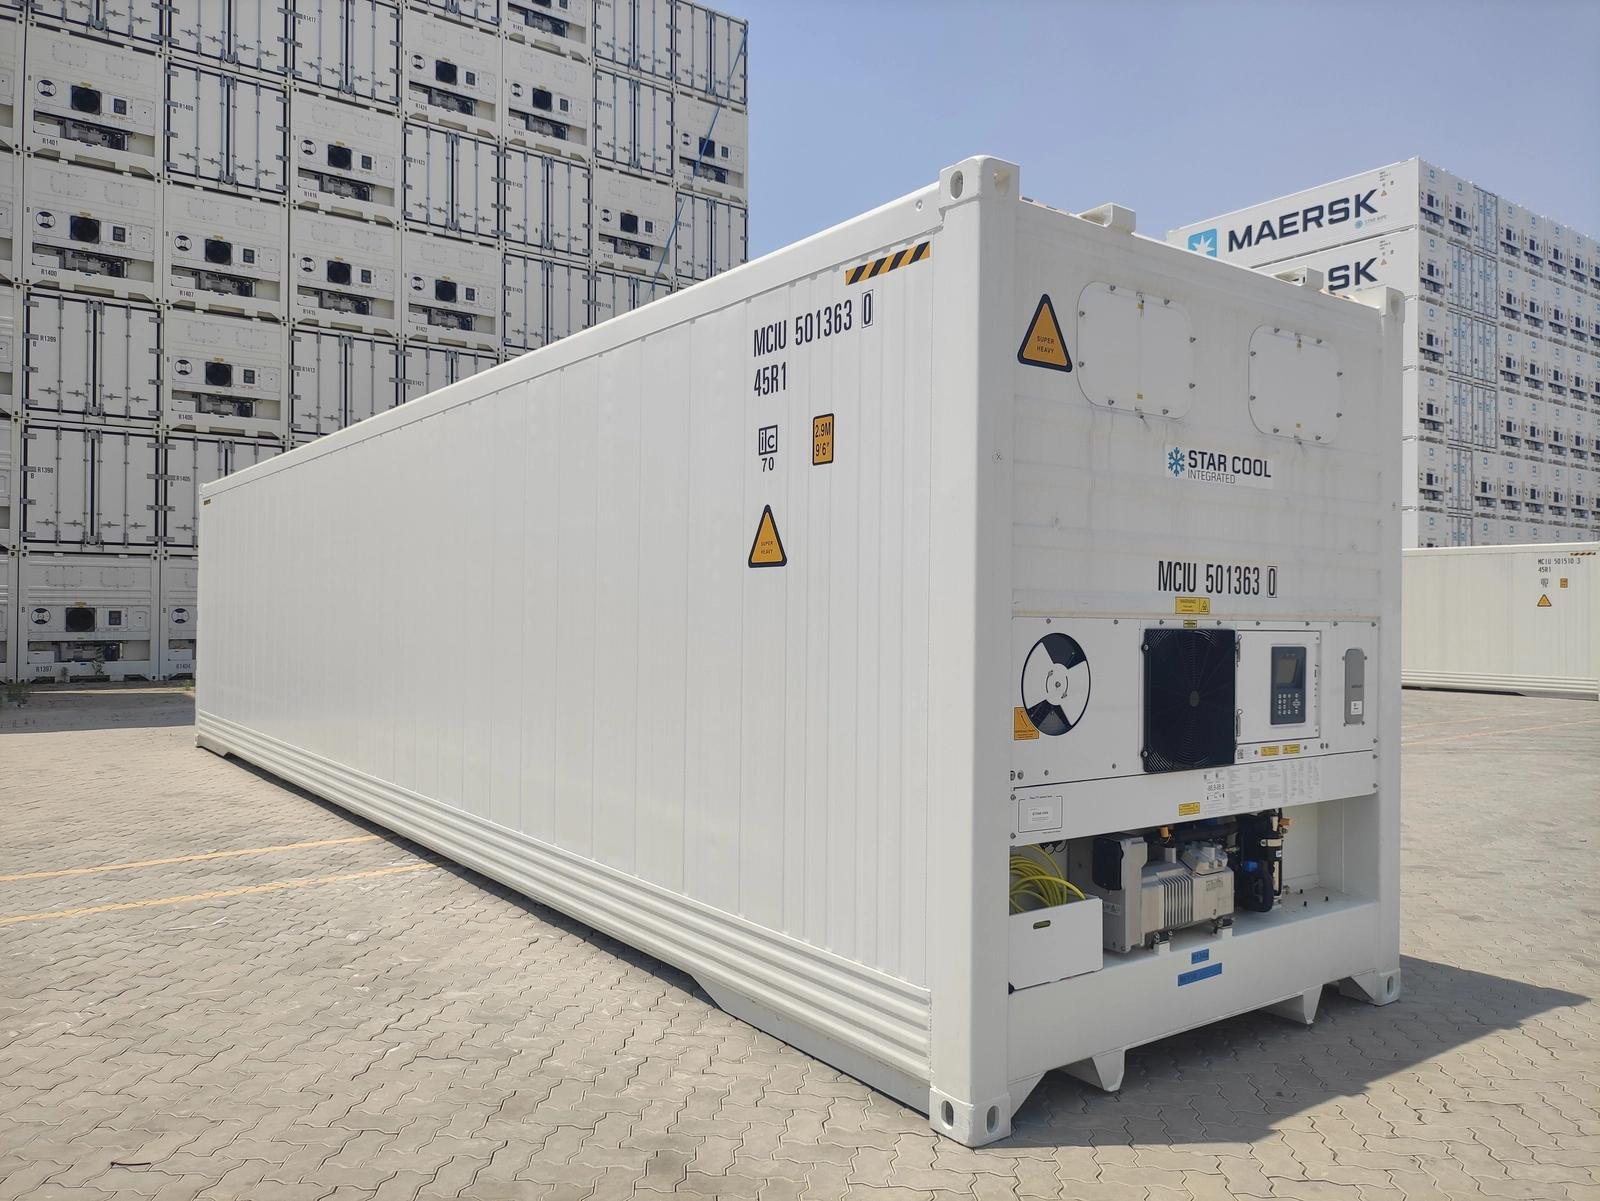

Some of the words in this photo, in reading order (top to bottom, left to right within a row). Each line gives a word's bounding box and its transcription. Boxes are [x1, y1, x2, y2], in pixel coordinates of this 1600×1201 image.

[1228, 189, 1378, 253] MAERSK
[754, 319, 787, 357] MCIU
[795, 299, 852, 346] 501363
[863, 292, 873, 327] 0
[40, 335, 57, 343] R1399
[1037, 335, 1055, 345] SUPER
[1036, 345, 1055, 354] HEAVY
[754, 361, 787, 397] 45R1
[815, 421, 832, 438] 2.9M
[38, 466, 54, 474] R1398
[761, 456, 775, 473] 70
[1188, 449, 1227, 473] STAR
[1232, 455, 1272, 478] COOL
[1187, 469, 1236, 485] INTEGRATED
[760, 539, 773, 547] SUPER
[760, 548, 773, 556] HEAVY
[1537, 558, 1552, 566] MCIU
[1158, 560, 1197, 593] MCIU
[1205, 563, 1260, 596] 501363
[1267, 566, 1277, 598] 0
